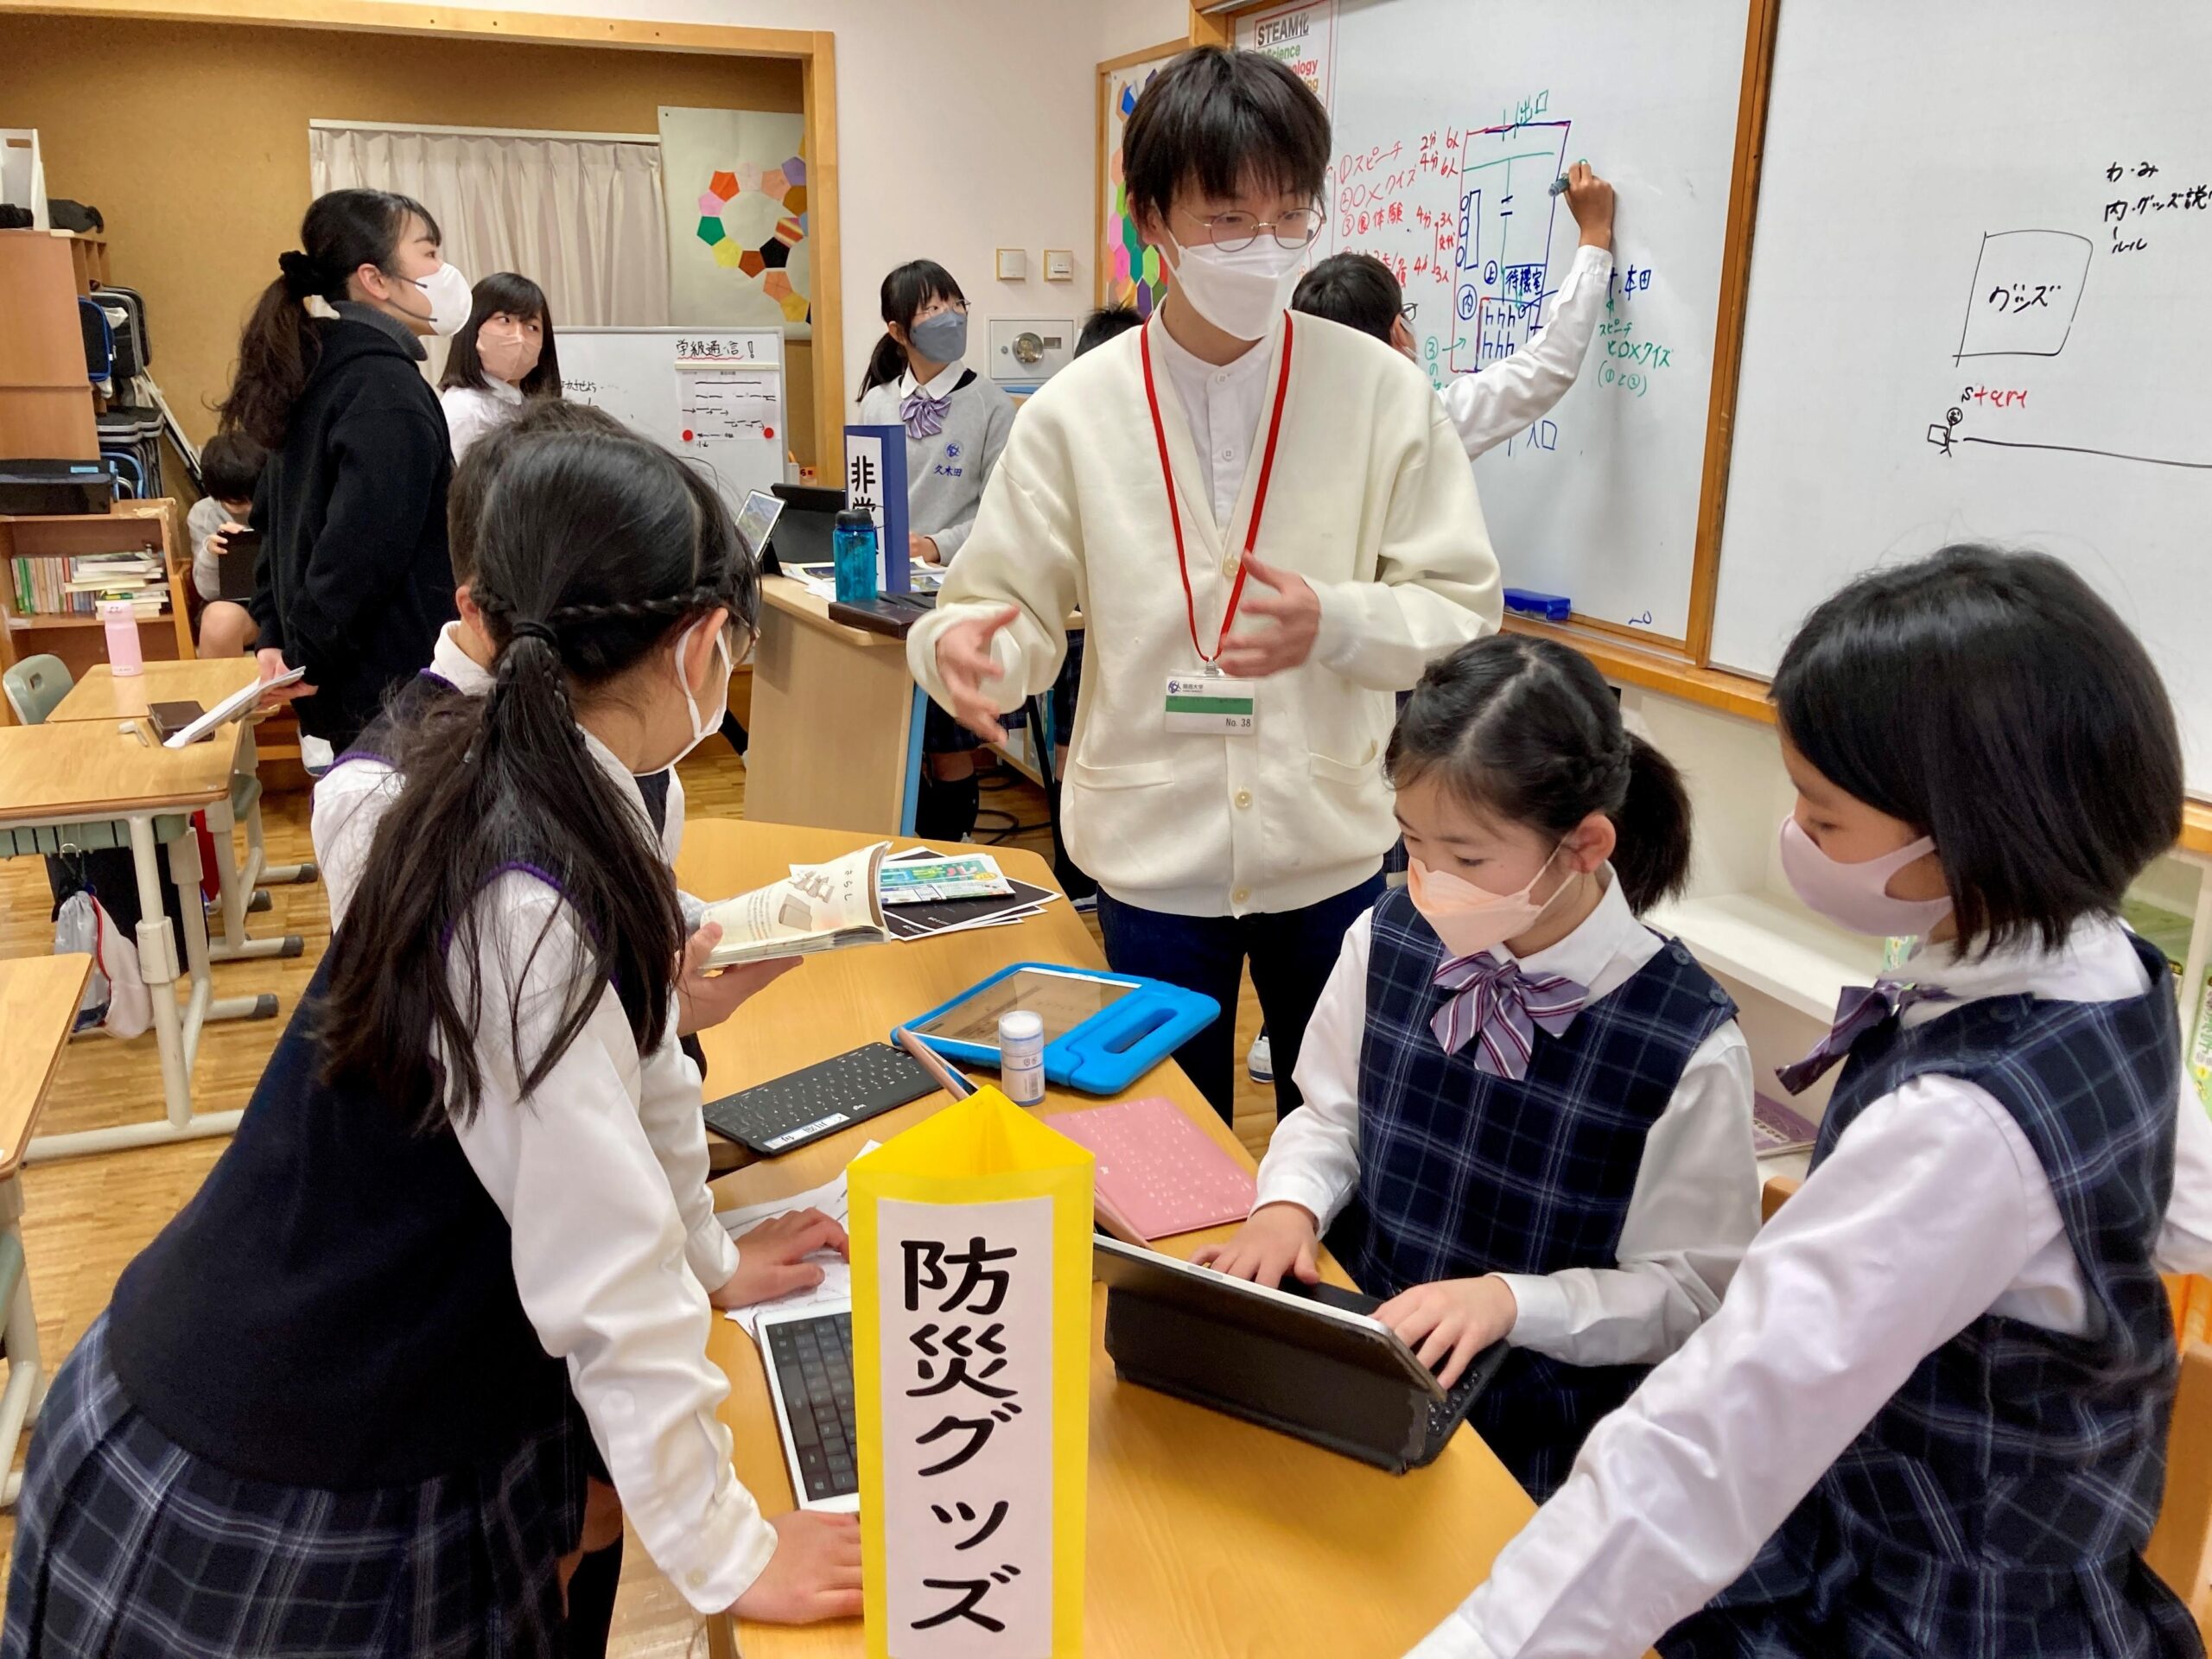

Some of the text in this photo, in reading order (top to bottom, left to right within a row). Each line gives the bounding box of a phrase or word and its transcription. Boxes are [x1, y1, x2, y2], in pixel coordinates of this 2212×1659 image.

[1292, 59, 1319, 76] ology
[1988, 283, 2062, 314] グッズ
[933, 464, 963, 477] 久木田
[1225, 718, 1251, 728] No. 38
[900, 1236, 1023, 1634] 防災グッズ
